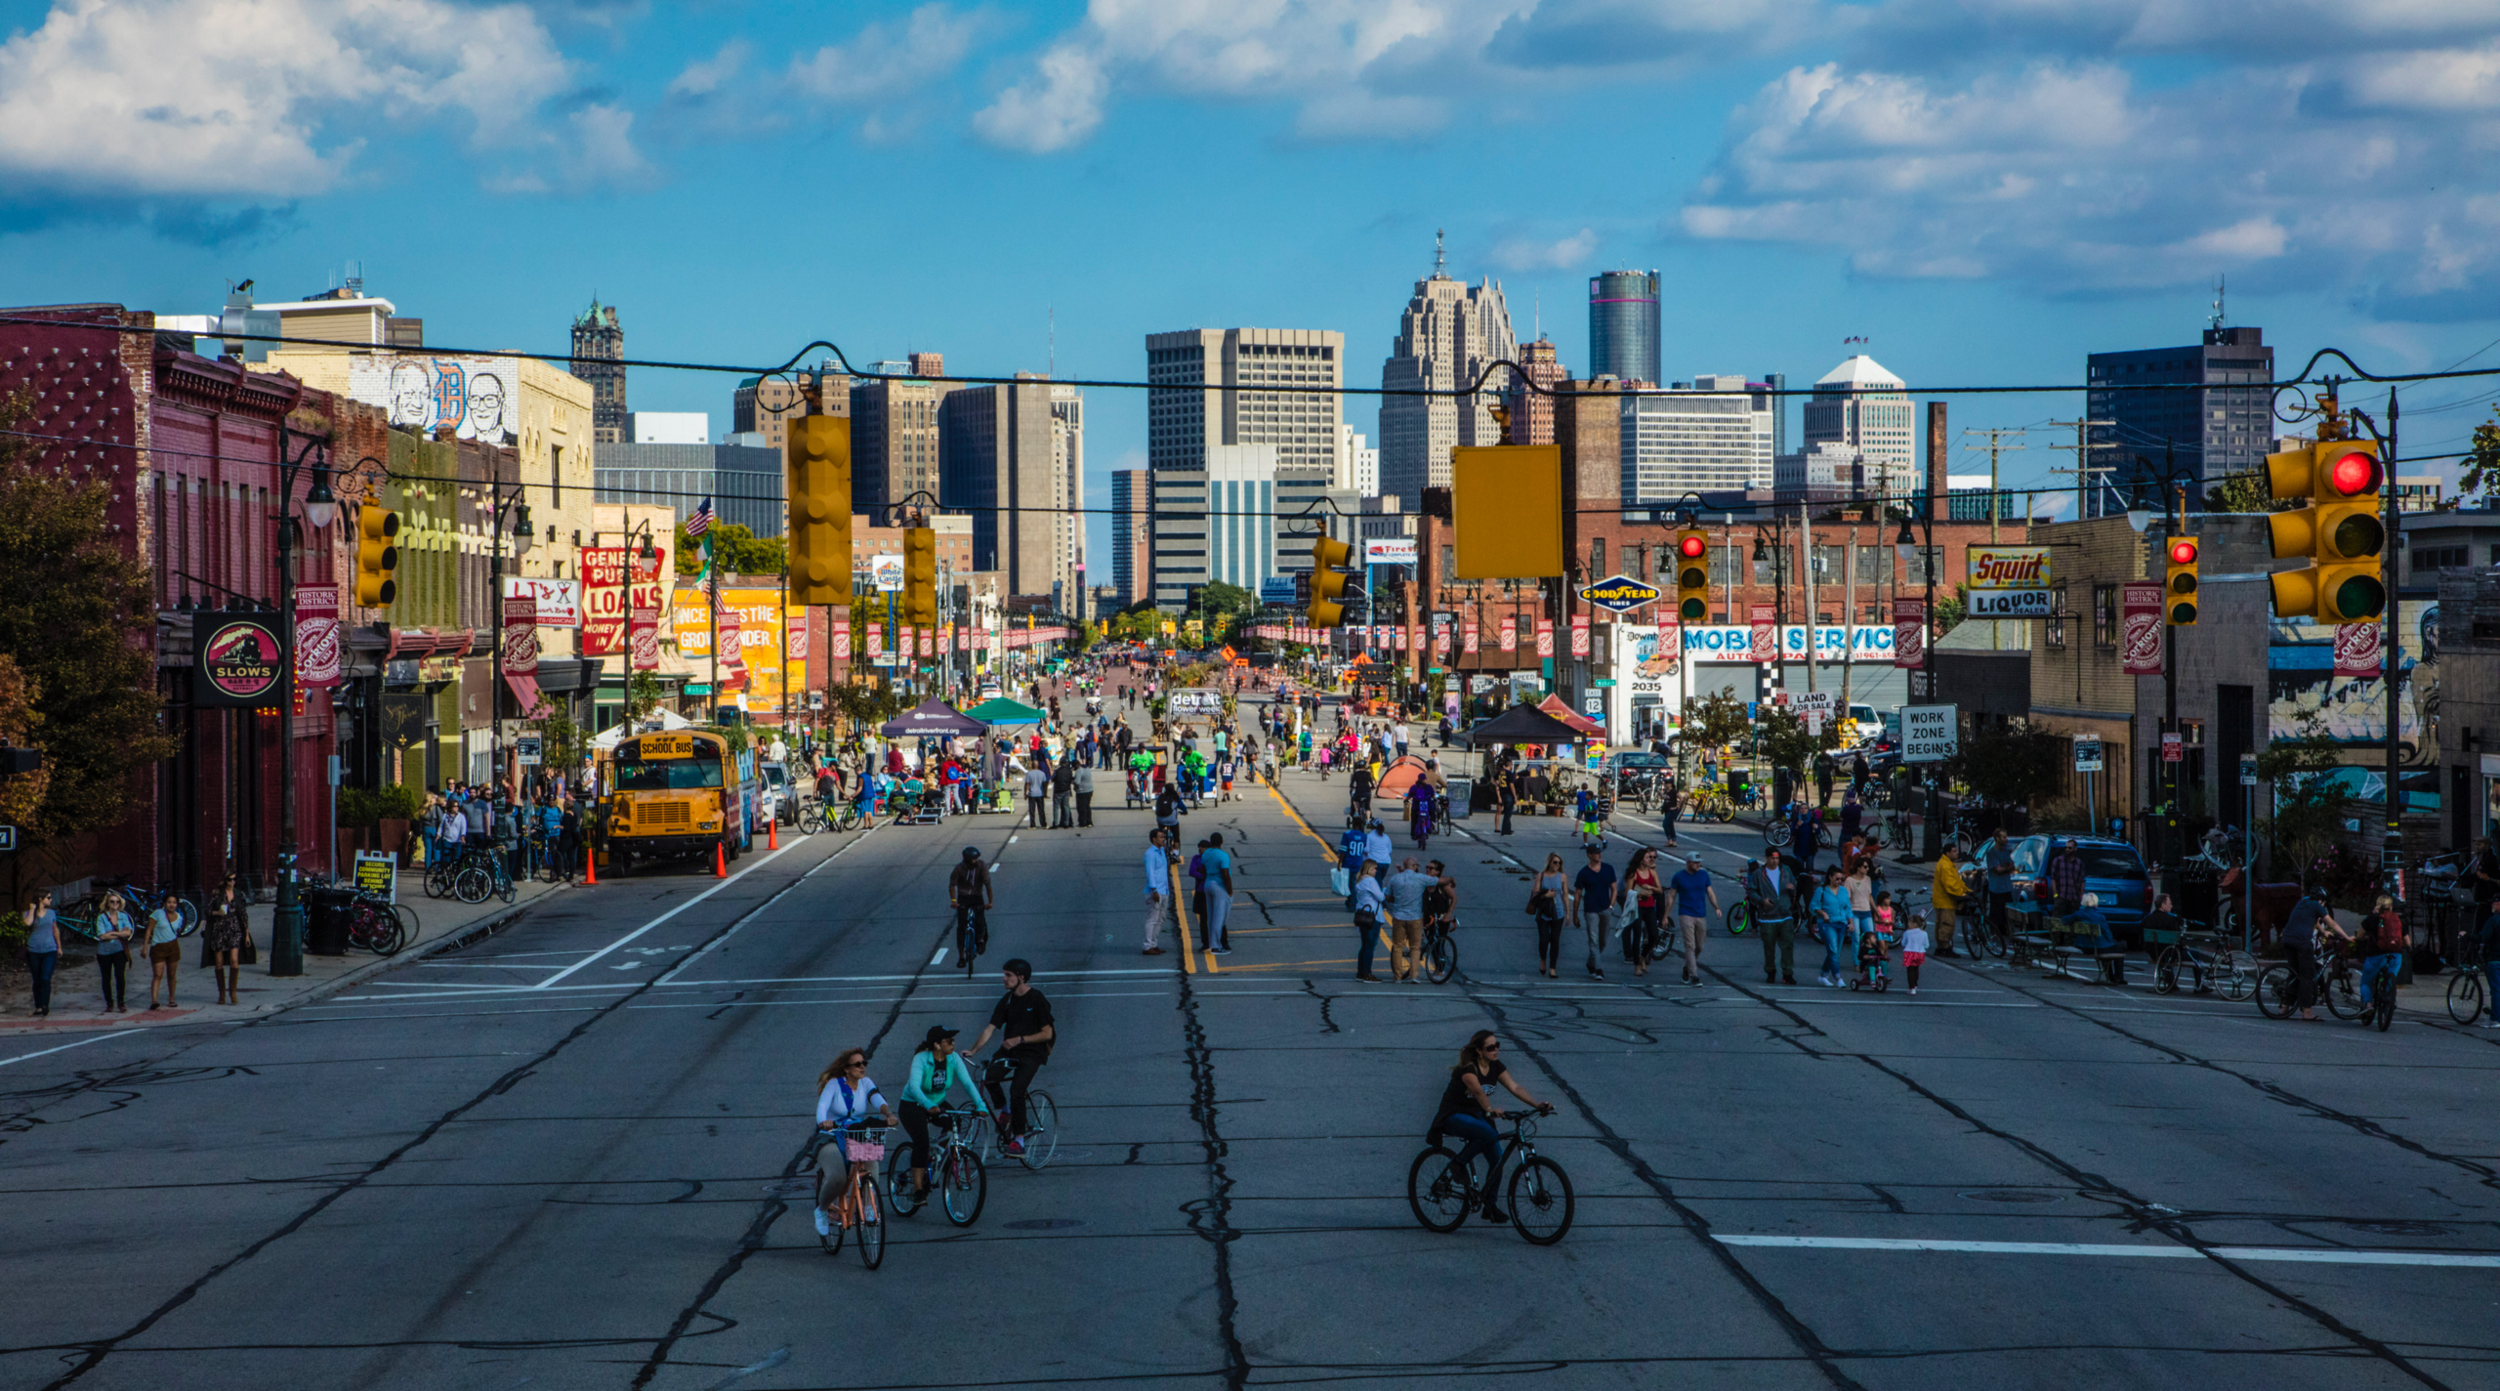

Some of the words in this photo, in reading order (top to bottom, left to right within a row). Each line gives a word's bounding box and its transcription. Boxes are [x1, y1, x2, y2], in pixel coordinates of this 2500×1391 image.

[586, 551, 658, 566] GENER
[1976, 553, 2043, 585] Squirt
[299, 591, 337, 599] HISTORIC
[1977, 592, 2048, 613] LIQUOR
[749, 606, 774, 622] THE
[584, 624, 615, 634] MONEY
[596, 636, 608, 647] IN
[739, 630, 774, 647] NDER.
[1788, 628, 1897, 650] SERVIC
[2334, 622, 2374, 663] Corkto
[216, 667, 271, 677] SLOWS
[1632, 683, 1662, 691] 2035
[1797, 694, 1826, 703] LAND
[1589, 702, 1600, 711] 12
[1794, 704, 1809, 712] FOR
[1811, 702, 1831, 710] SALE
[1910, 712, 1945, 723] WORK
[905, 722, 960, 735] detroitriverfront.org
[1912, 728, 1945, 739] ZONE
[642, 742, 673, 754] SCHOOL
[676, 742, 692, 753] BUS
[1907, 742, 1953, 755] BEGINS
[1350, 841, 1364, 857] 90
